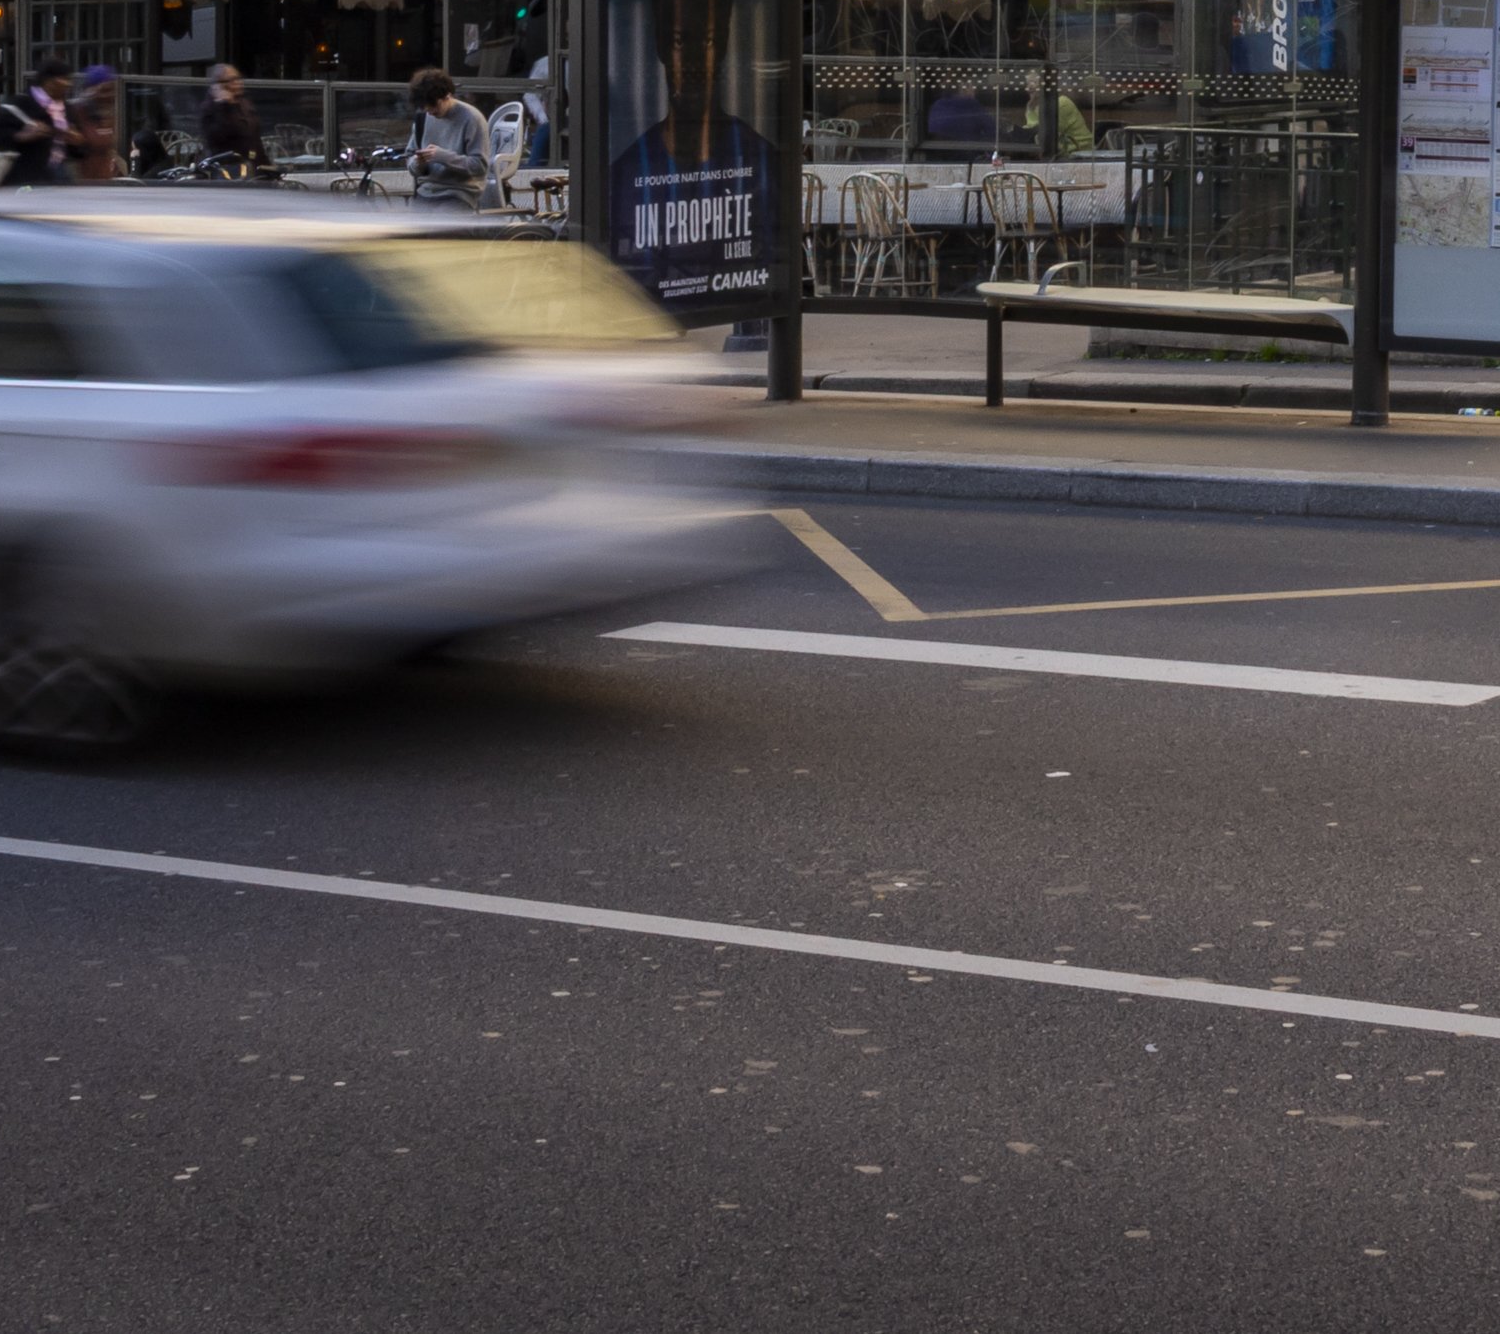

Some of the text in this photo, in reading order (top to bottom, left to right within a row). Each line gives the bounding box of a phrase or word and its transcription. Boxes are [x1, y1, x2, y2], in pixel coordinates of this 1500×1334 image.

[1402, 136, 1413, 147] 39
[634, 177, 643, 187] LE
[644, 174, 680, 187] POUVOIR
[700, 169, 721, 181] DANS
[722, 167, 753, 179] L'OMBRE
[635, 188, 753, 249] UN PROPHÈTE
[724, 243, 733, 260] LA
[711, 268, 769, 292] CANAL+
[663, 284, 708, 298] SEULEMENT SUR
